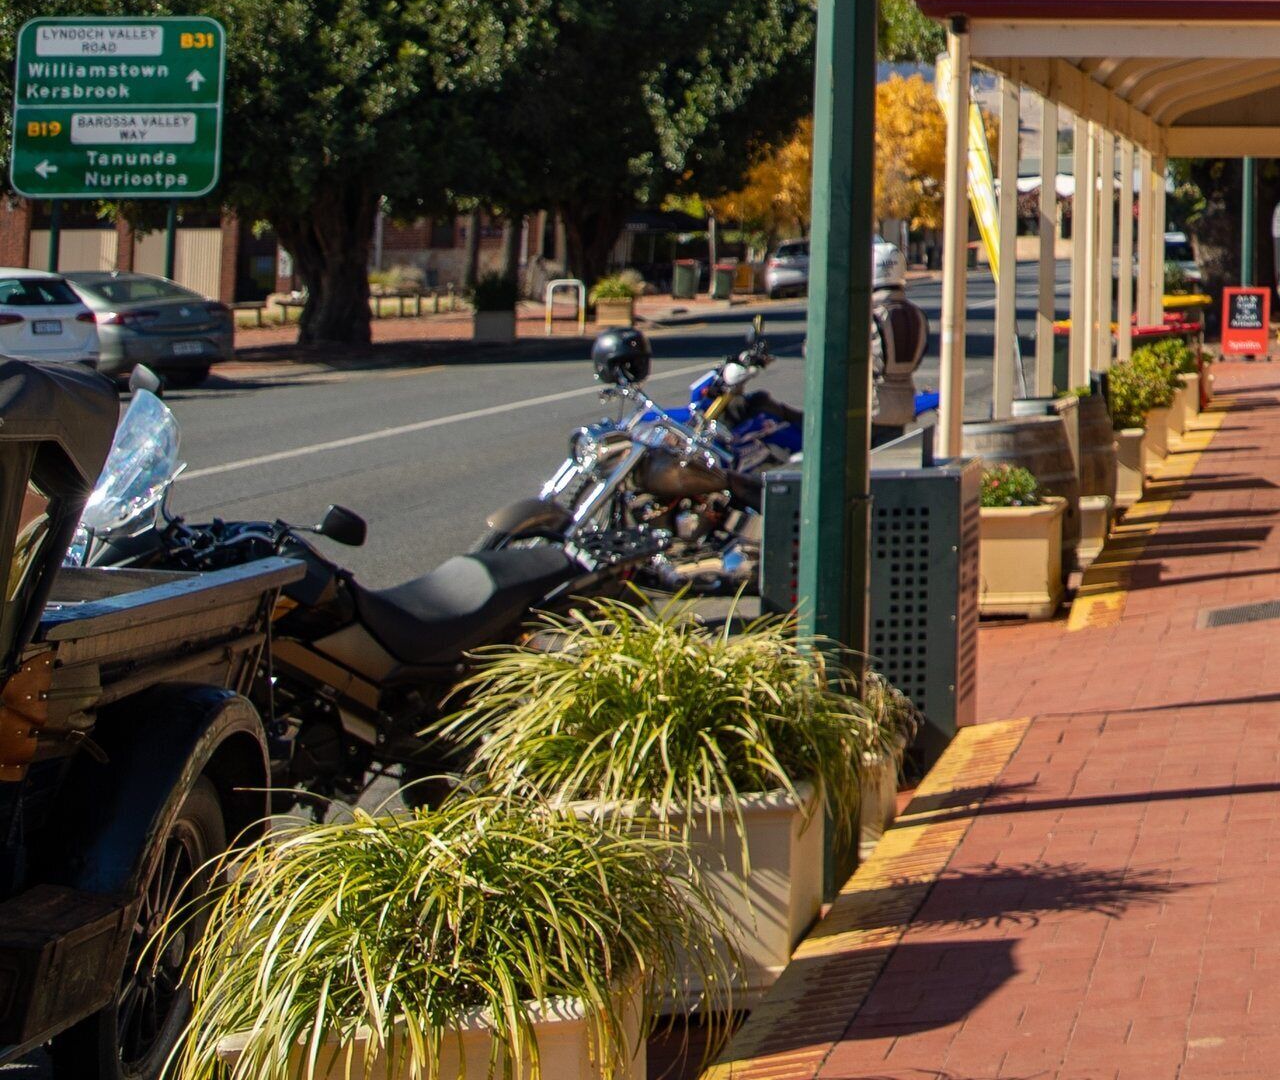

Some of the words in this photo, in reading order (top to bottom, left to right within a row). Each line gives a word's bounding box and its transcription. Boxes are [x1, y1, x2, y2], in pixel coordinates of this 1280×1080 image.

[109, 28, 158, 40] VALLEY
[180, 32, 215, 49] B31
[82, 42, 117, 53] ROAD
[28, 62, 169, 78] Williamstown
[26, 83, 130, 98] Kersbrook
[27, 121, 62, 137] B19
[142, 117, 190, 128] VALLEY
[119, 130, 148, 140] WAY
[87, 151, 177, 166] Tanunda
[85, 172, 188, 189] Nuriootpa
